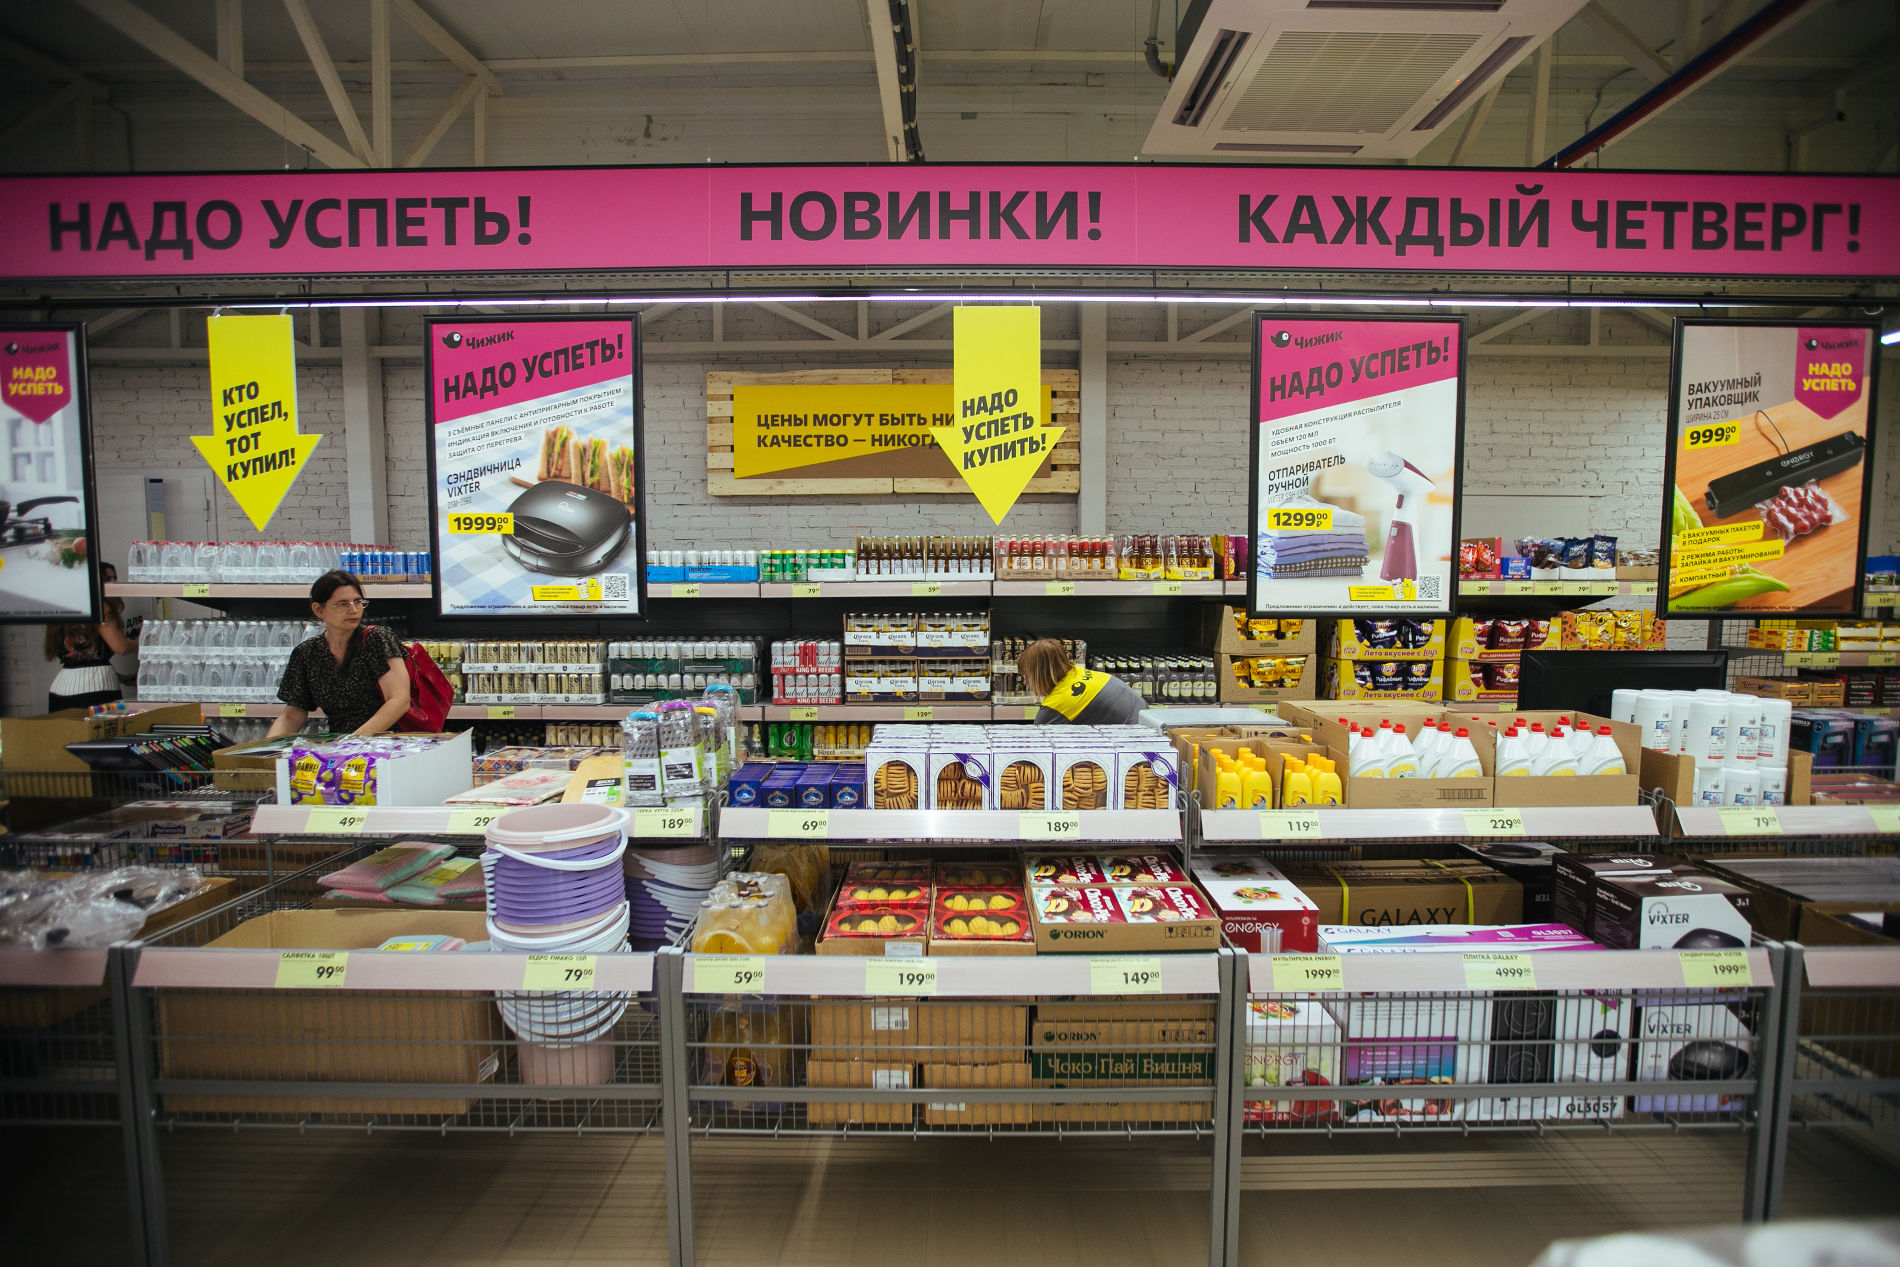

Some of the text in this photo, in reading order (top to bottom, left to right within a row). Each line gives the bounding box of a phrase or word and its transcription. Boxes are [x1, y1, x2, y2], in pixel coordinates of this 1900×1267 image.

[740, 190, 1102, 241] НОВИНКИ!
[1238, 184, 1861, 257] КАЖДЫЙ ЧЕТВЕРГ!
[49, 196, 532, 261] НАДО УСПЕТЬ!
[466, 330, 515, 350] Чижик
[1294, 330, 1343, 350] Чижик
[12, 366, 57, 382] НАДО
[443, 333, 623, 404] НАДО УСПЕТЬ!
[1269, 336, 1450, 403] НАДО УСПЕТЬ!
[1808, 363, 1853, 377] НАДО
[8, 382, 64, 396] УСПЕТЬ
[1687, 372, 1762, 396] ВАКУУМНЫЙ
[1802, 379, 1856, 392] УСПЕТЬ
[222, 381, 259, 407] КТО
[1687, 390, 1760, 411] УПАКОВЩИК
[486, 414, 514, 429] ПАНЕЛИ
[513, 412, 519, 421] С
[519, 398, 579, 420] АНТИПРИГАРНЫМ
[579, 387, 622, 405] ПОКРЫТИЕМ
[962, 388, 1018, 419] НАДО
[223, 400, 289, 432] УСПЕЛ,
[757, 412, 955, 428] ЦЕНЫ МОГУТ БЫТЬ НИ
[1271, 400, 1402, 437] УДОБНАЯ КОНСТРУКЦИЯ РАСПЫЛИТЕЛЯ
[447, 400, 615, 448] ИНДИКАЦИЯ ВКЛЮЧЕНИЯ И ГОТОВНОСТИ К РАБОТЕ
[962, 411, 1035, 445] УСПЕТЬ
[226, 431, 262, 456] ТОТ
[757, 434, 941, 449] КАЧЕСТВО НИКОГД
[1295, 433, 1307, 442] 120
[1307, 430, 1319, 440] МЛ
[1689, 427, 1725, 445] 999
[447, 435, 524, 459] ЗАЩИТА ОТ ПЕРЕГРЕВА
[962, 433, 1047, 471] КУПИТЬ!
[1270, 437, 1337, 459] МОЩНОСТЬ 1000 ВТ
[227, 448, 297, 482] КУПИЛ!
[446, 457, 522, 485] СЭНДВИЧНИЦА
[1268, 454, 1346, 482] ОТПАРИВАТЕЛЬ
[447, 481, 481, 498] VIXTER
[1268, 474, 1310, 495] РУЧНОЙ
[453, 516, 496, 531] 1999
[1273, 512, 1316, 527] 1299
[1687, 527, 1729, 539] ВАКУУМНЫХ
[1729, 524, 1761, 534] ПАКЕТОВ
[1687, 536, 1721, 546] ПОДАРОК
[1686, 551, 1716, 561] РЕЖИМА
[1717, 547, 1745, 557] РАБОТЫ:
[1718, 549, 1782, 564] ВАКУУМИРОВАНИЕ
[1679, 570, 1728, 583] КОМПАКТНЫЙ
[1265, 603, 1303, 611] Предложение
[1383, 650, 1415, 659] вкуснее
[1383, 691, 1415, 700] вкуснее
[339, 817, 356, 827] 49
[661, 818, 684, 829] 189
[802, 820, 818, 831] 69
[1046, 821, 1070, 832] 189
[1287, 821, 1310, 832] 119
[1490, 819, 1513, 829] 229
[1753, 817, 1769, 827] 79
[1360, 907, 1456, 926] GALAXY
[1063, 929, 1105, 940] ORION
[316, 966, 335, 978] 99
[564, 969, 583, 982] 79
[1304, 969, 1332, 979] 1999
[1495, 968, 1523, 978] 4999
[1712, 964, 1739, 975] 1999
[734, 971, 753, 984] 59
[898, 973, 925, 985] 199
[1122, 972, 1149, 984] 149
[1057, 1031, 1098, 1042] ORION
[1047, 1057, 1203, 1075] Чоко Пай Вишня
